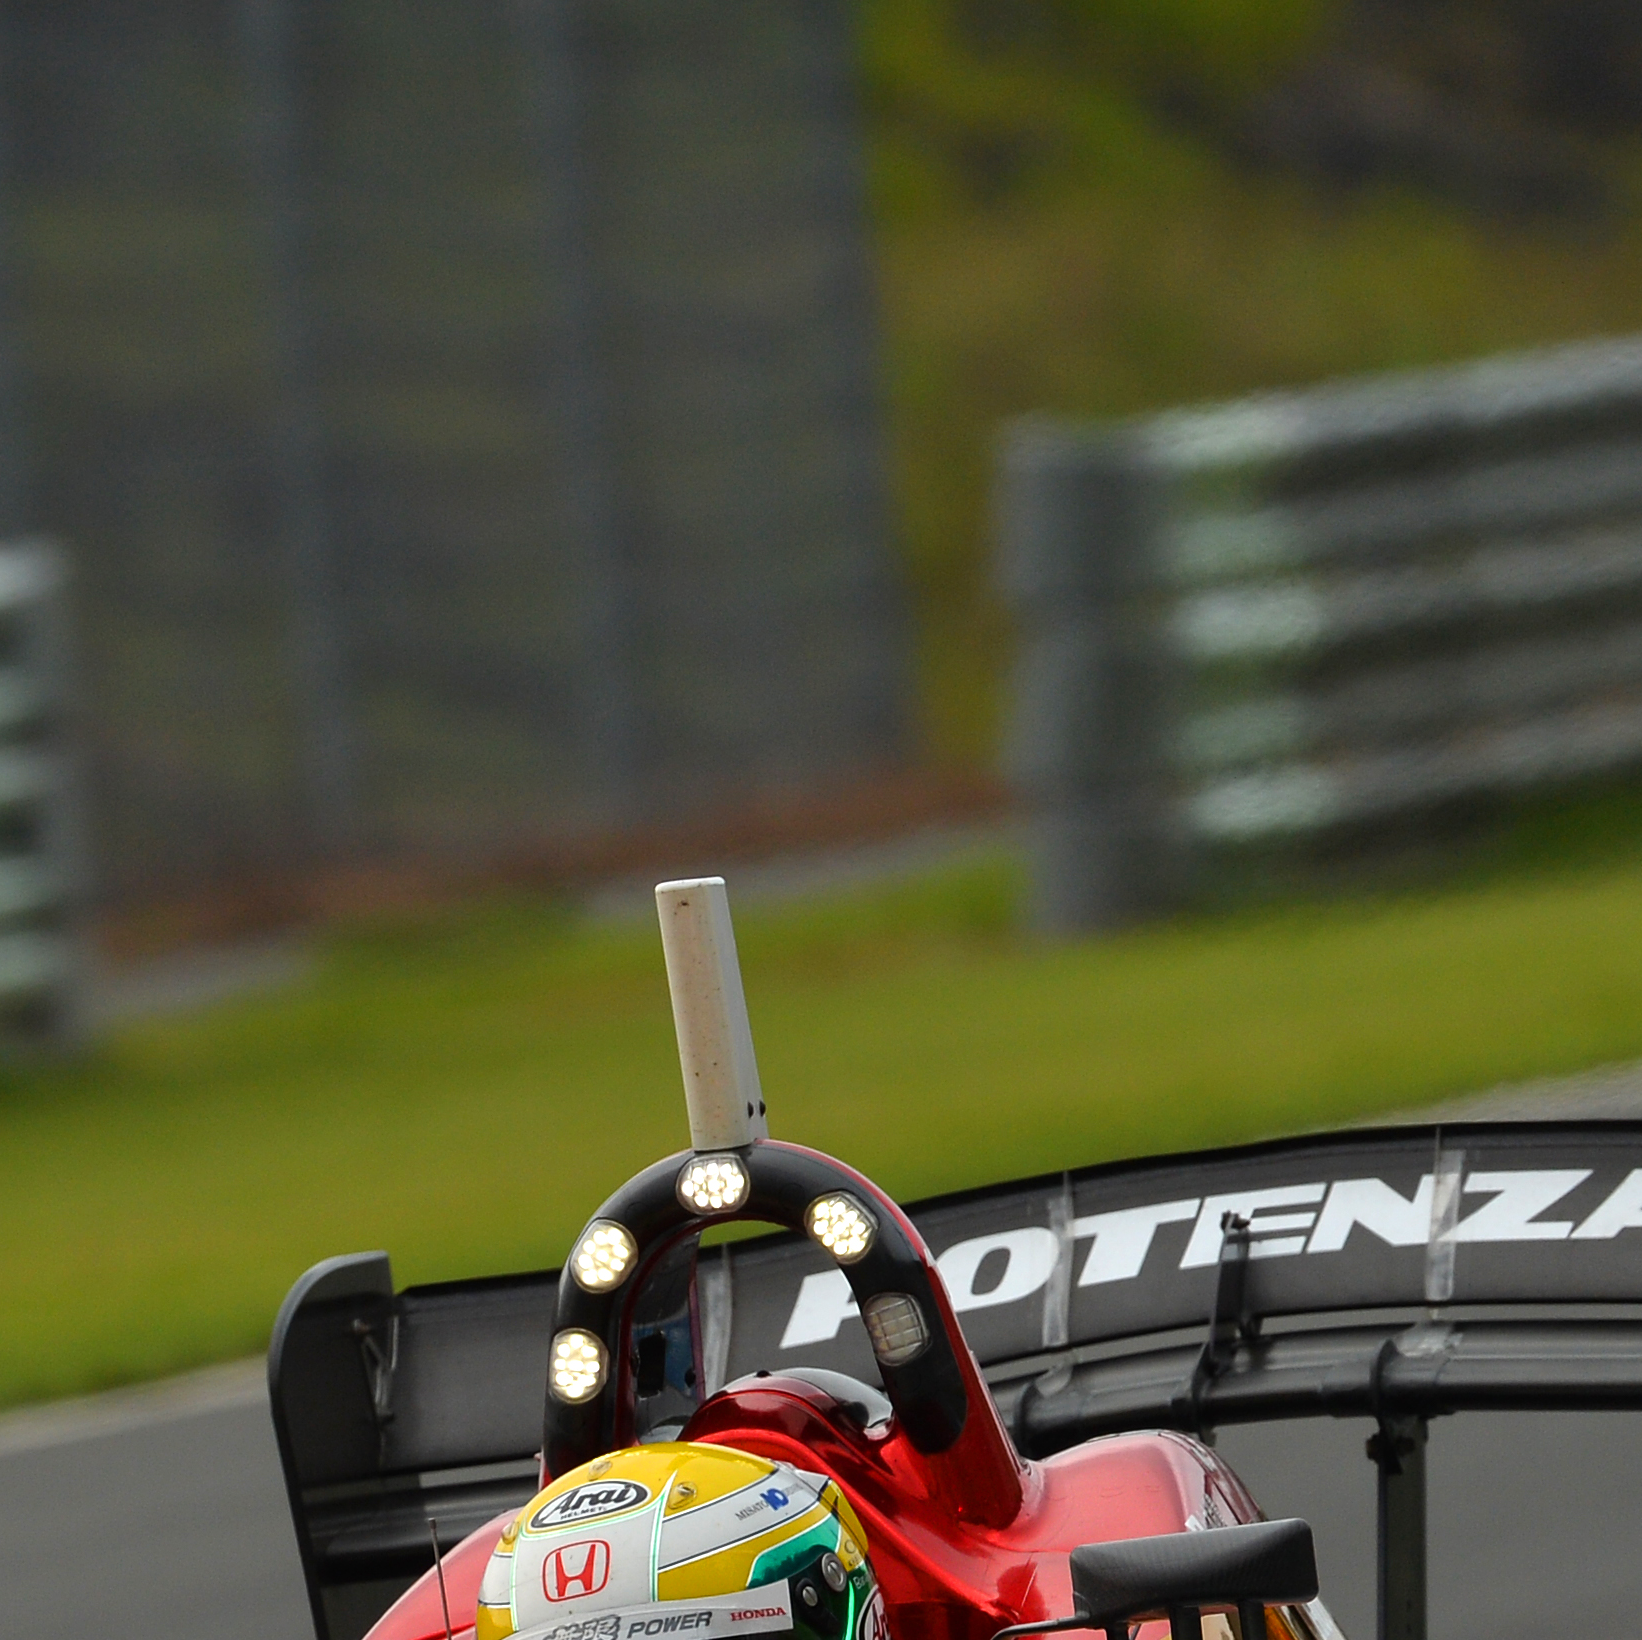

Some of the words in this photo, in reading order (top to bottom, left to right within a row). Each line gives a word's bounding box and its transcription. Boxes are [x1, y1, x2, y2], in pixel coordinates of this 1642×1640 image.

[540, 1484, 634, 1524] Arai
[627, 1611, 713, 1639] POWER
[730, 1606, 786, 1622] HONDA
